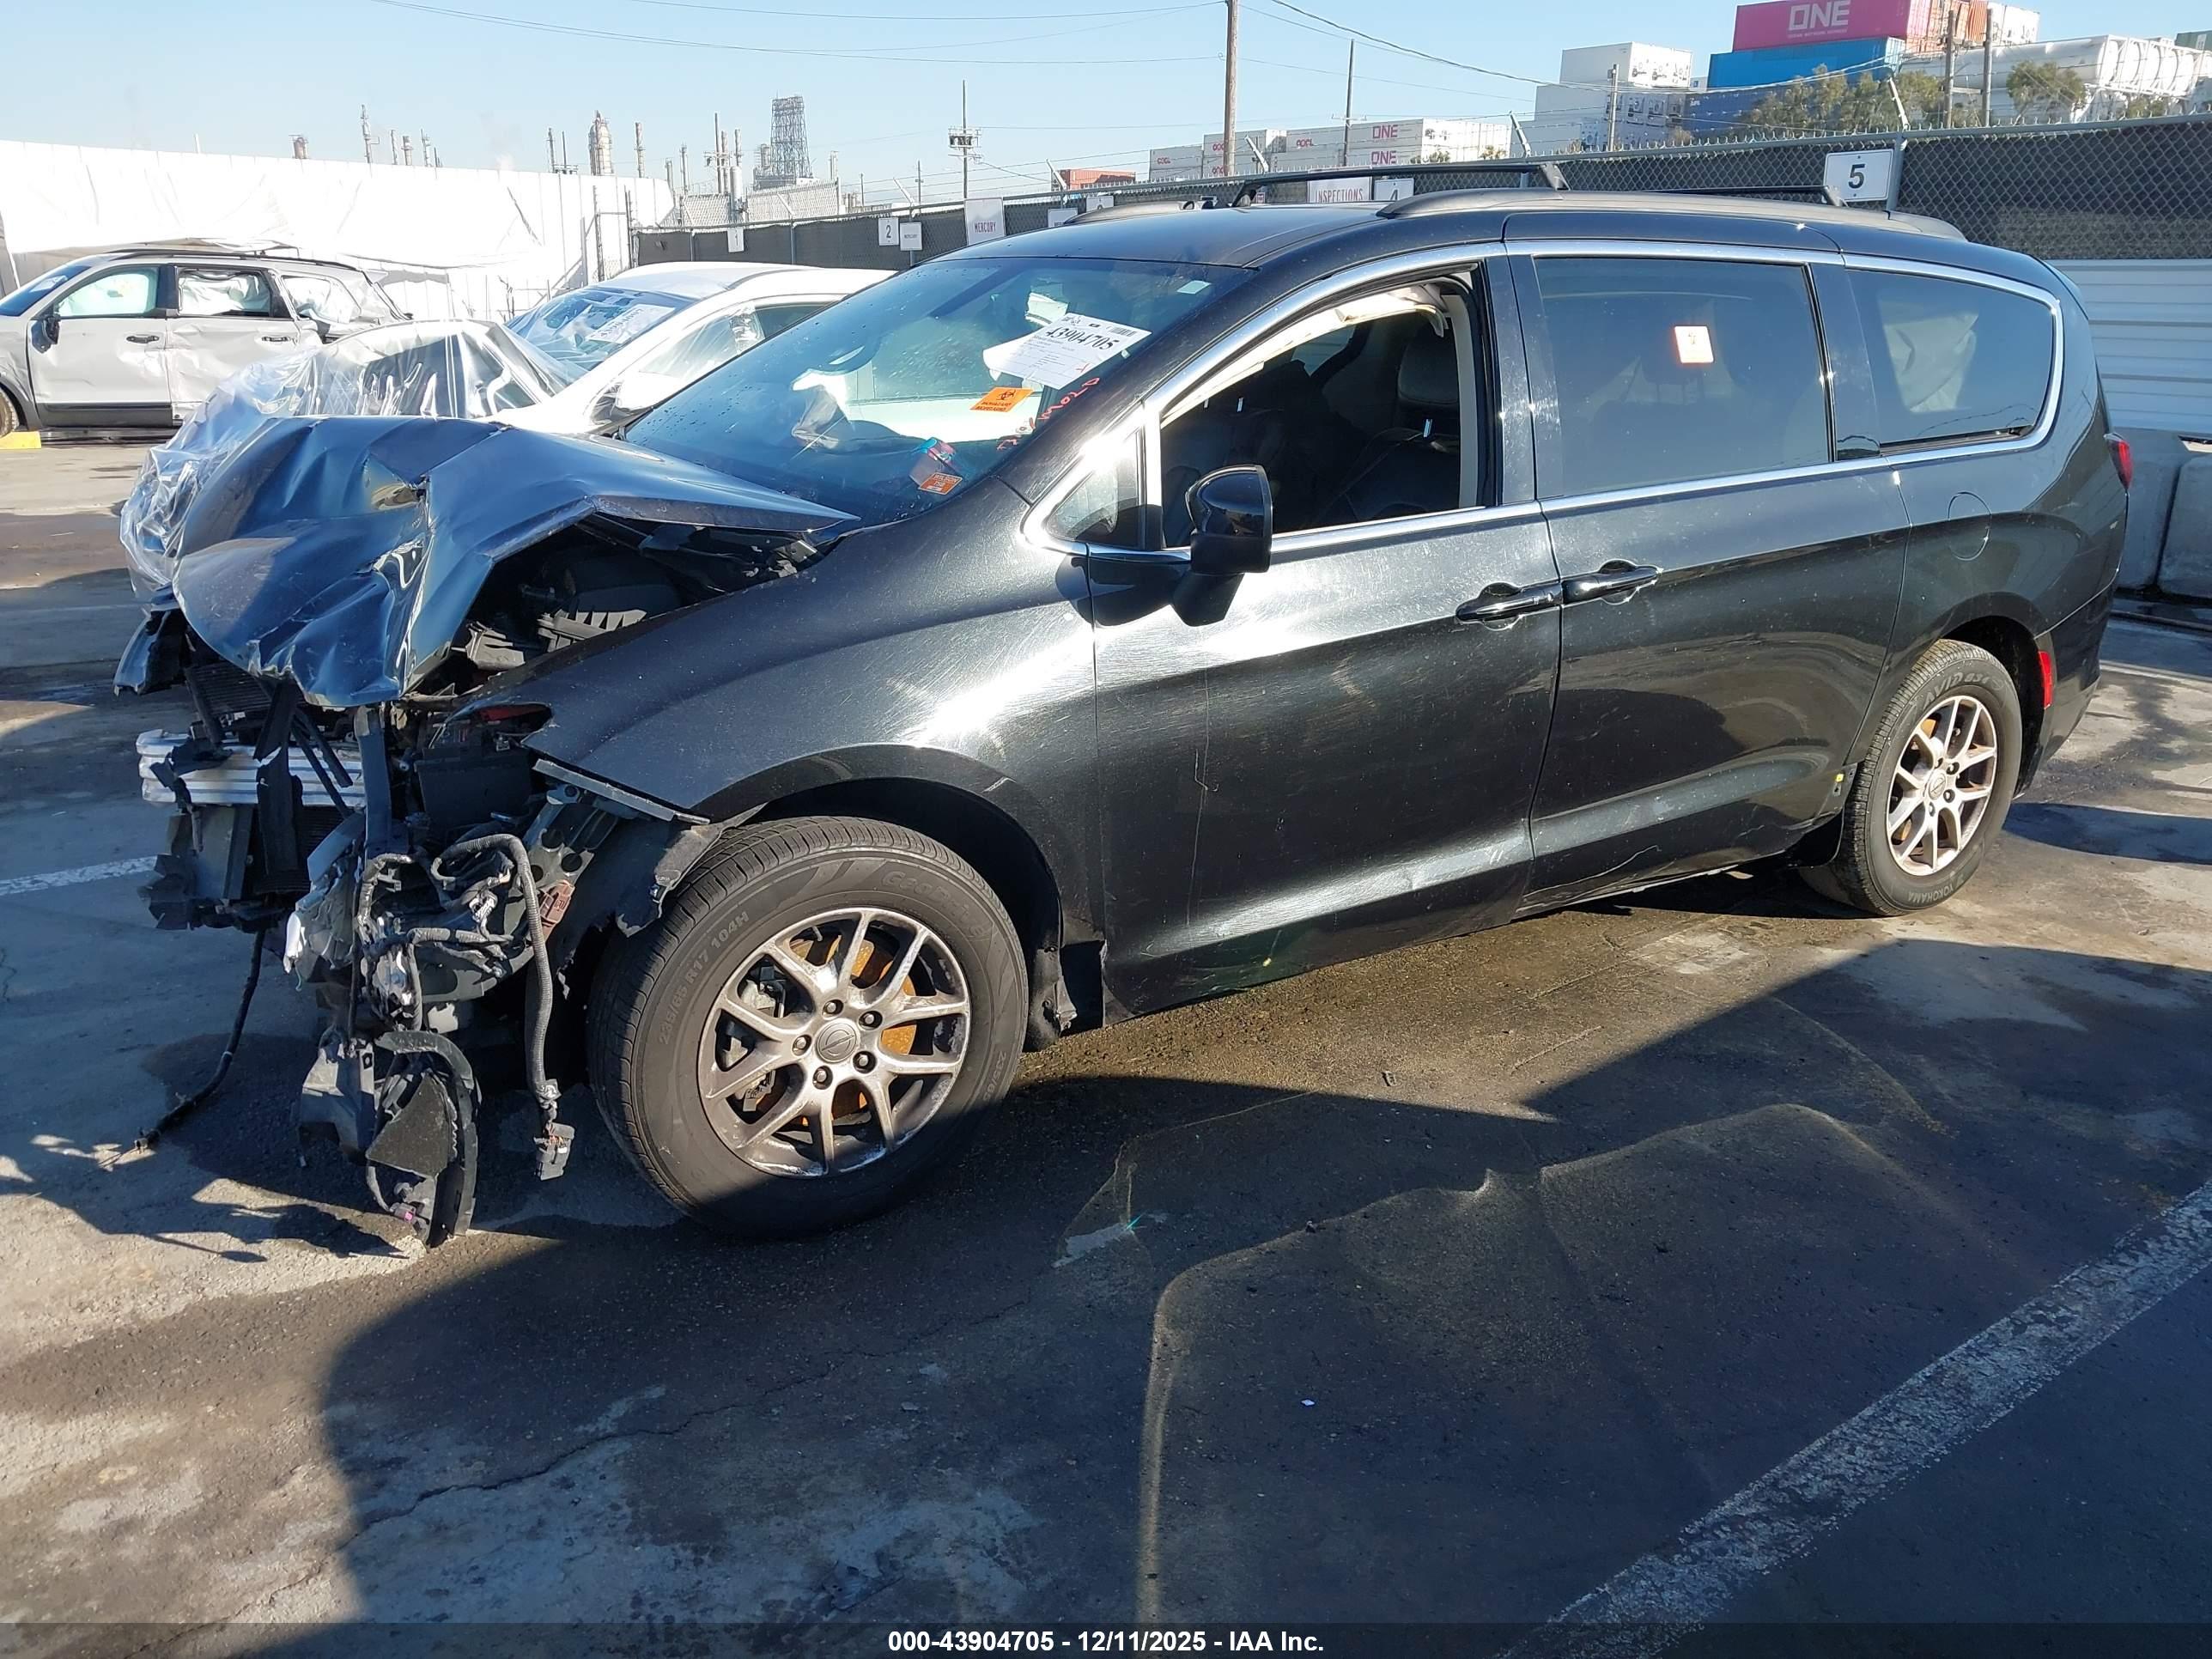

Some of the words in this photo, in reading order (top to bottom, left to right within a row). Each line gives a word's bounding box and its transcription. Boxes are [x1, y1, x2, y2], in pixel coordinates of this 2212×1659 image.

[1789, 0, 1851, 31] ONE
[1373, 125, 1398, 139] ONE
[1371, 150, 1396, 165] ONE
[1848, 163, 1866, 190] 5
[885, 225, 891, 239] 2
[974, 221, 996, 233] MERCURY
[1046, 326, 1120, 350] 43904705
[1907, 883, 1954, 904] YOKOHAMA
[684, 949, 709, 984] R17
[711, 910, 750, 949] 104H
